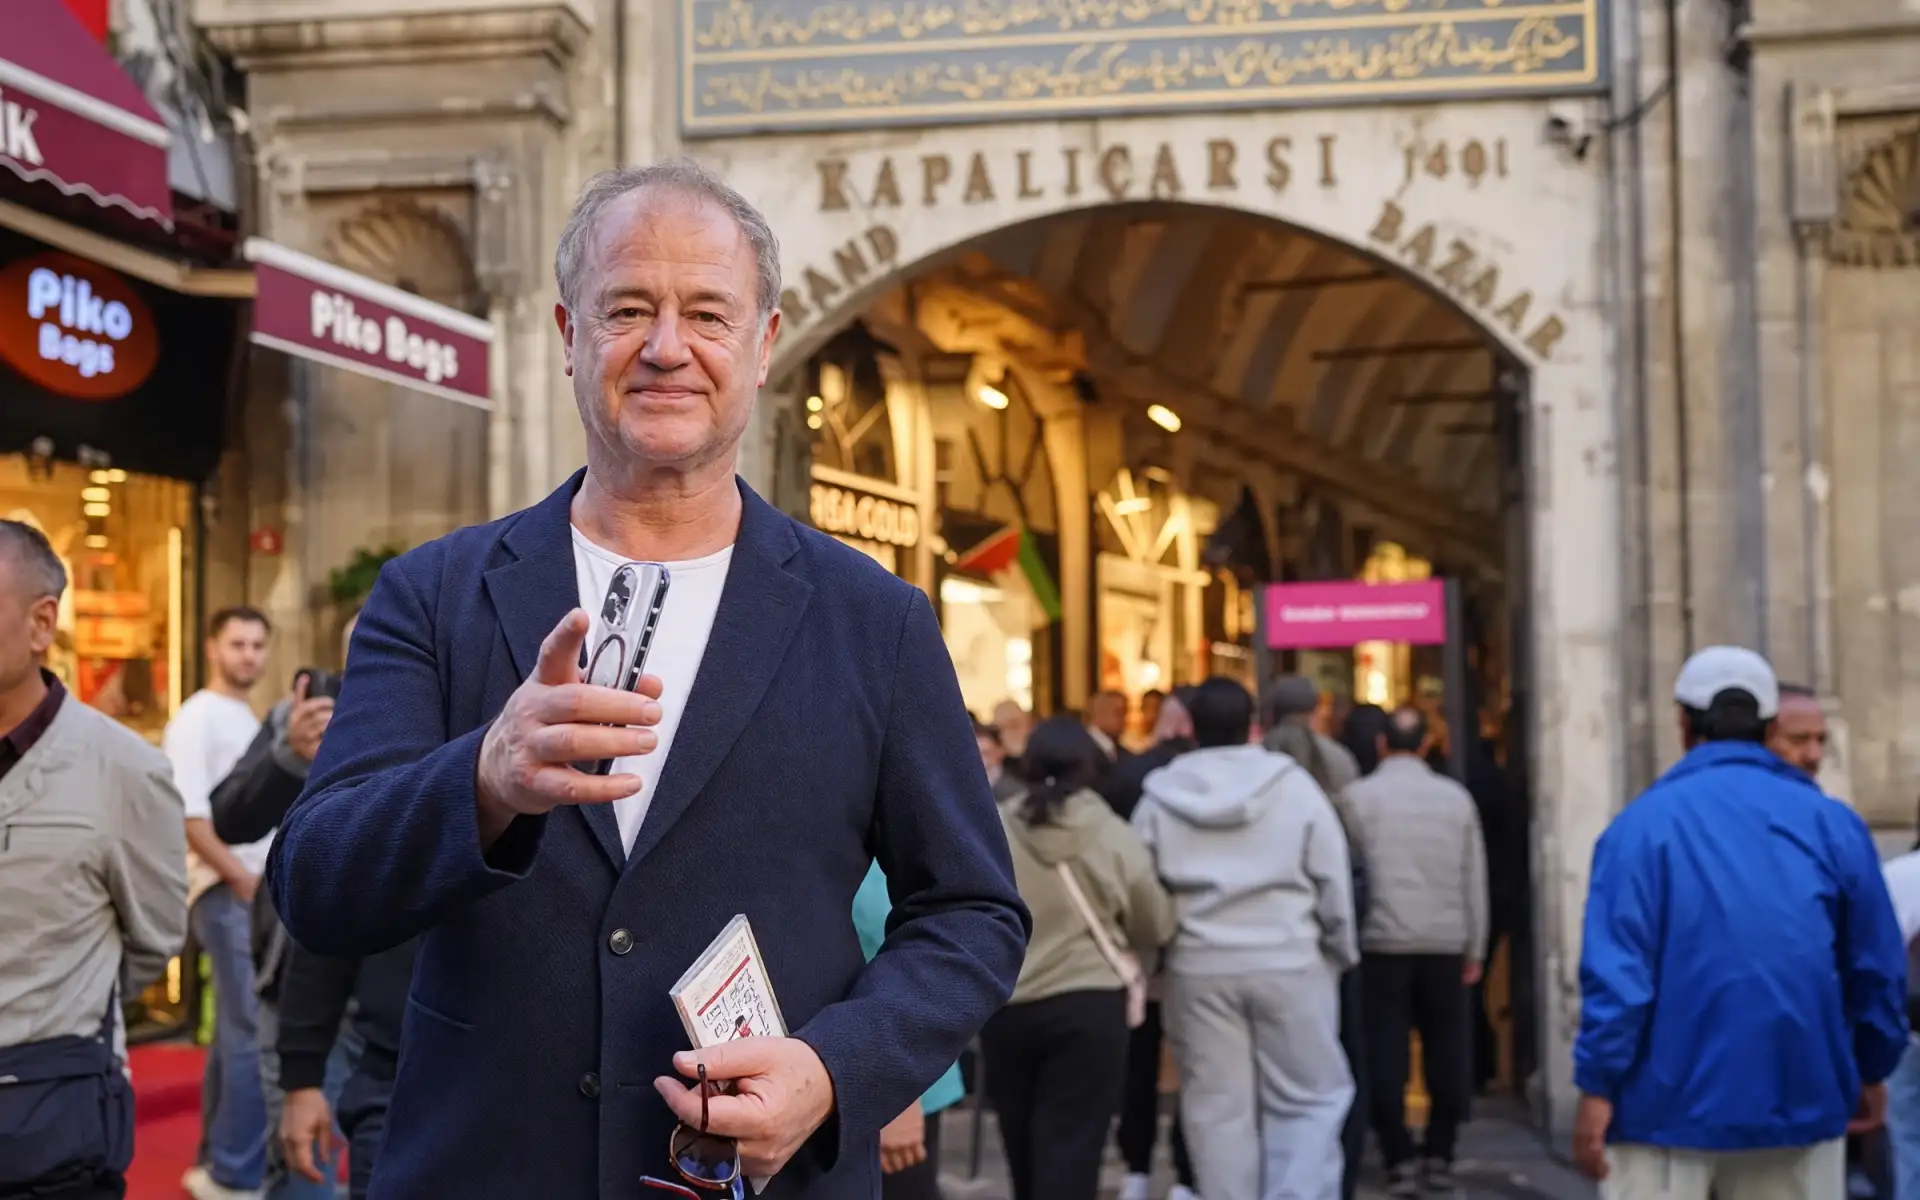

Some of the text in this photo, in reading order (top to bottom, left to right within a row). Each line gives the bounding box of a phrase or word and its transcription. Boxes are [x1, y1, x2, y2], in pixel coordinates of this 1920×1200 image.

[817, 134, 1338, 212] KAPALIÇARŞI
[27, 266, 134, 341] Piko
[778, 199, 1567, 360] RAND BAZAAR
[38, 321, 116, 379] Bags
[310, 289, 459, 384] Piko Bags
